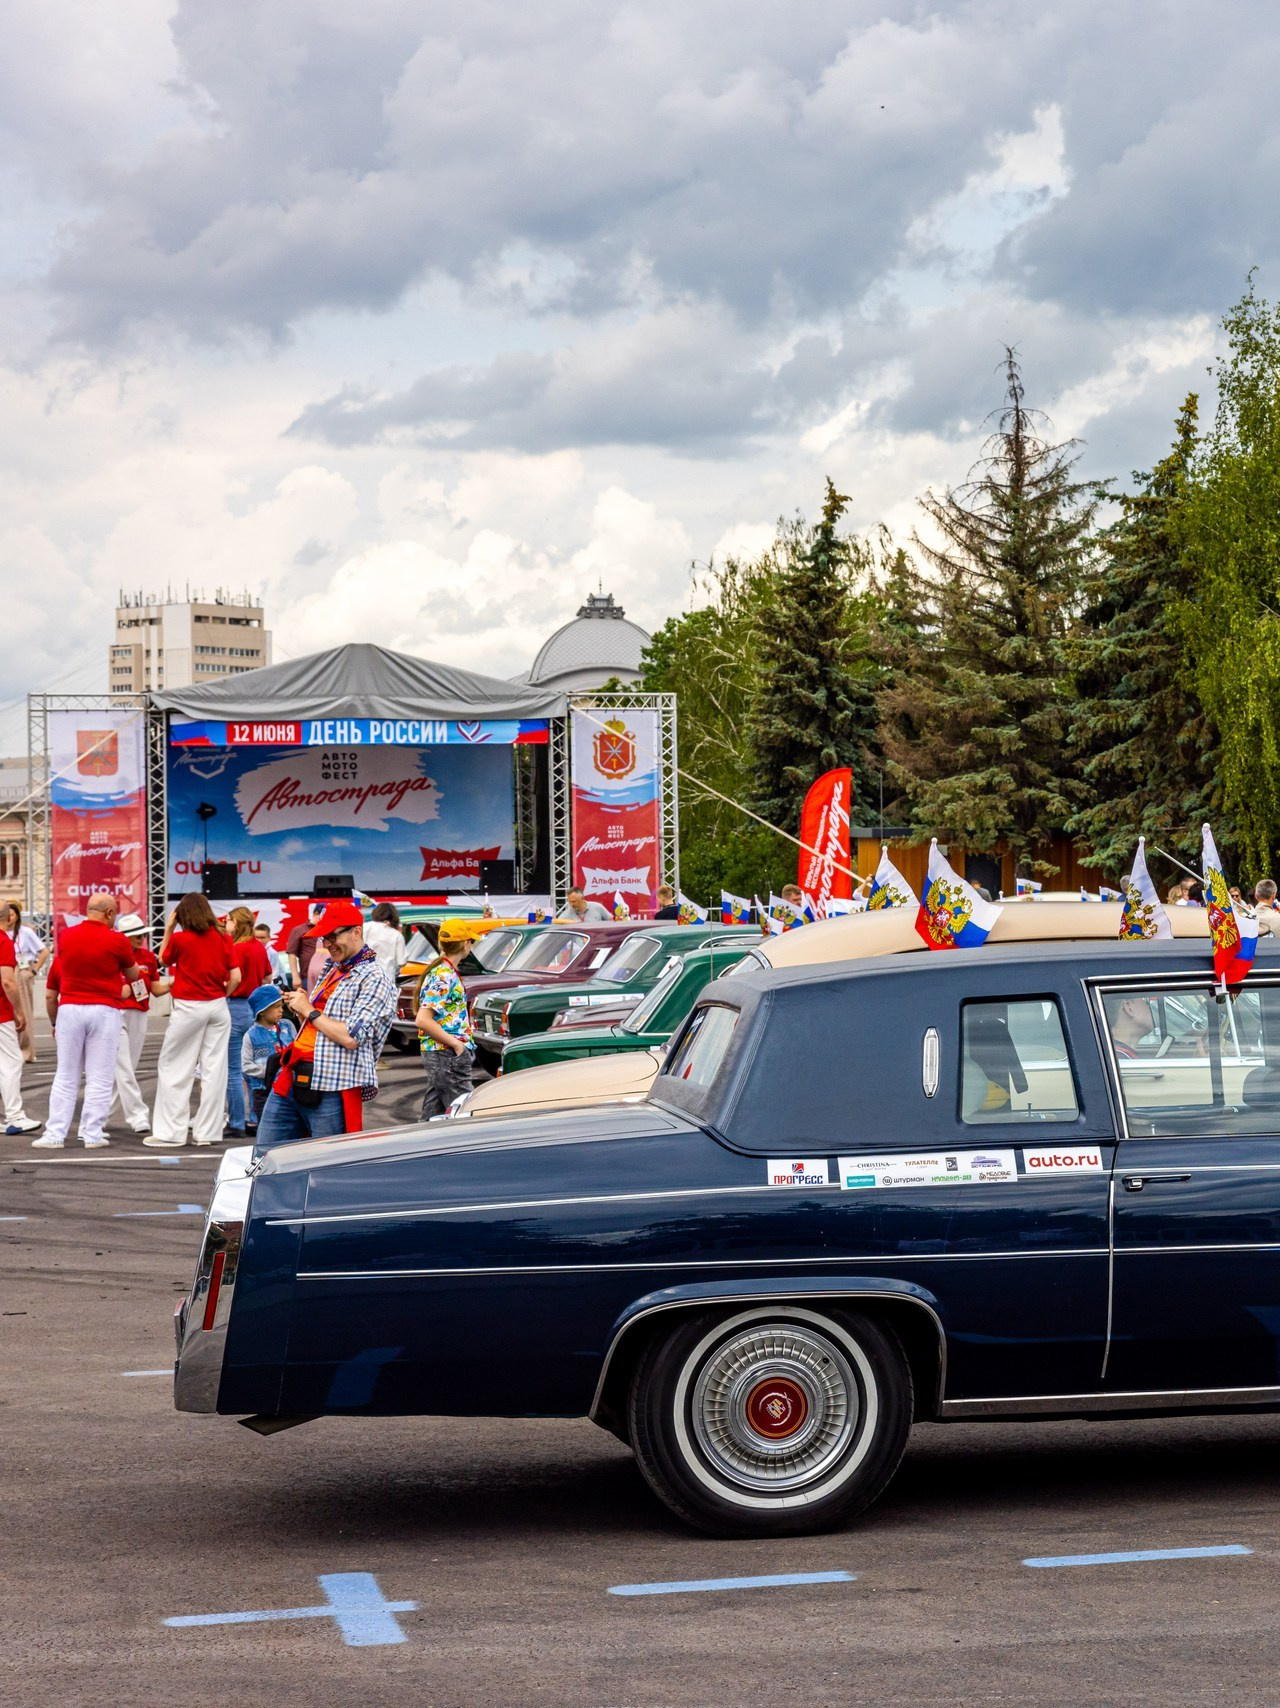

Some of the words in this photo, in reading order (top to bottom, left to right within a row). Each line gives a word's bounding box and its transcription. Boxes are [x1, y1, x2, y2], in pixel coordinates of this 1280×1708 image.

[233, 725, 250, 742] 12
[253, 725, 295, 742] ИЮНЯ
[308, 720, 362, 745] ДЕНЬ
[369, 720, 448, 744] РОССИИ
[322, 752, 358, 761] АВТО
[322, 762, 358, 770] МОТО
[322, 771, 358, 780] ФЕСТ
[247, 776, 431, 825] Автострада
[56, 842, 142, 864] Автострада
[576, 836, 656, 858] Автострада
[430, 858, 464, 871] Альфа
[591, 876, 619, 887] Альфа
[67, 883, 133, 896] auto.ru
[1028, 1154, 1099, 1168] auto.ru
[774, 1174, 823, 1185] ПРОГРЕСС
[893, 1176, 925, 1184] штурман
